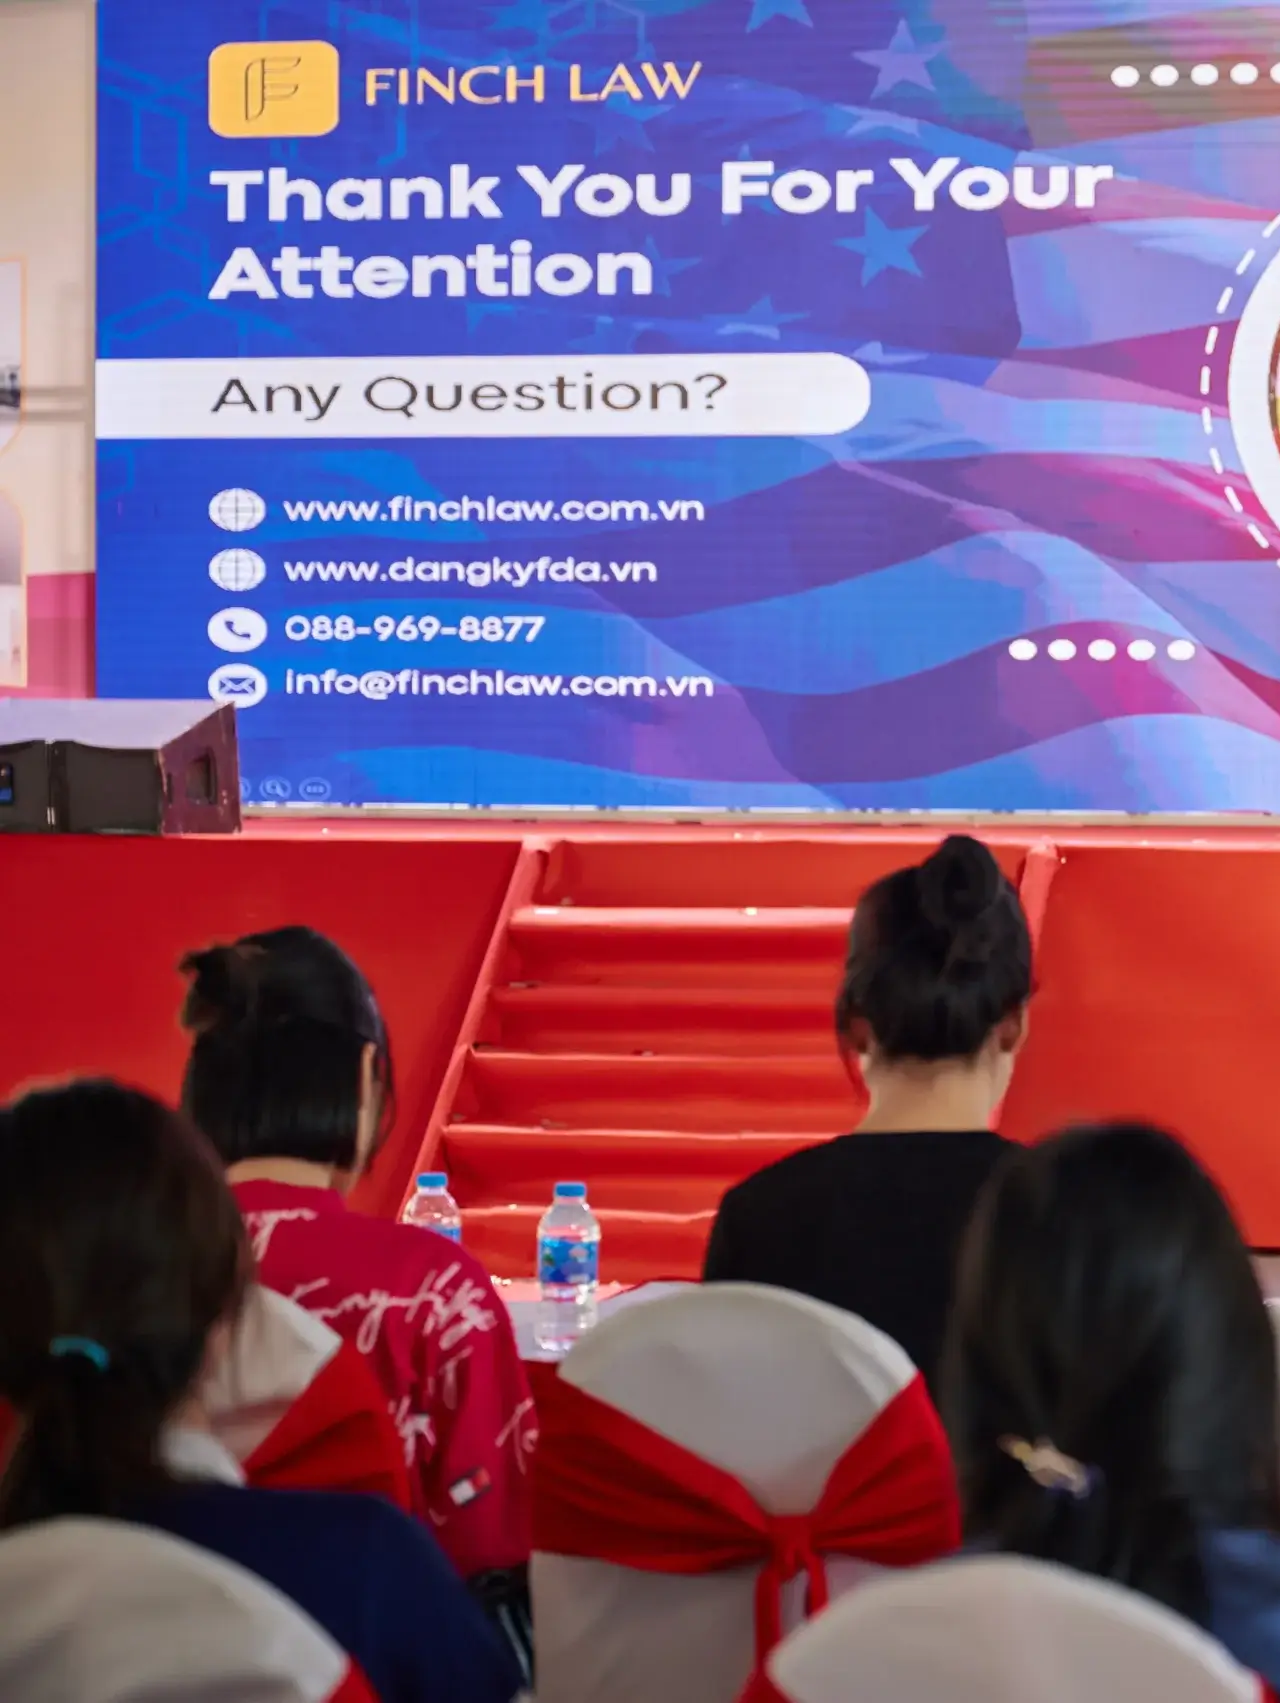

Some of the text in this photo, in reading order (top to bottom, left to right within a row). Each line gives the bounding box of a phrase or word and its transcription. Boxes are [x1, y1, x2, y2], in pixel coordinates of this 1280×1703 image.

[365, 64, 544, 106] FINCH
[570, 61, 702, 103] LAW
[209, 157, 1113, 222] Thank You For Your
[208, 238, 653, 300] Attention
[210, 372, 729, 421] Any Question?
[284, 495, 704, 522] www.finchlaw.com.vn
[284, 556, 658, 588] www.dangkyfda.vn
[285, 615, 546, 643] 088-969-8877
[285, 669, 714, 700] info@finchlaw.com.vn
